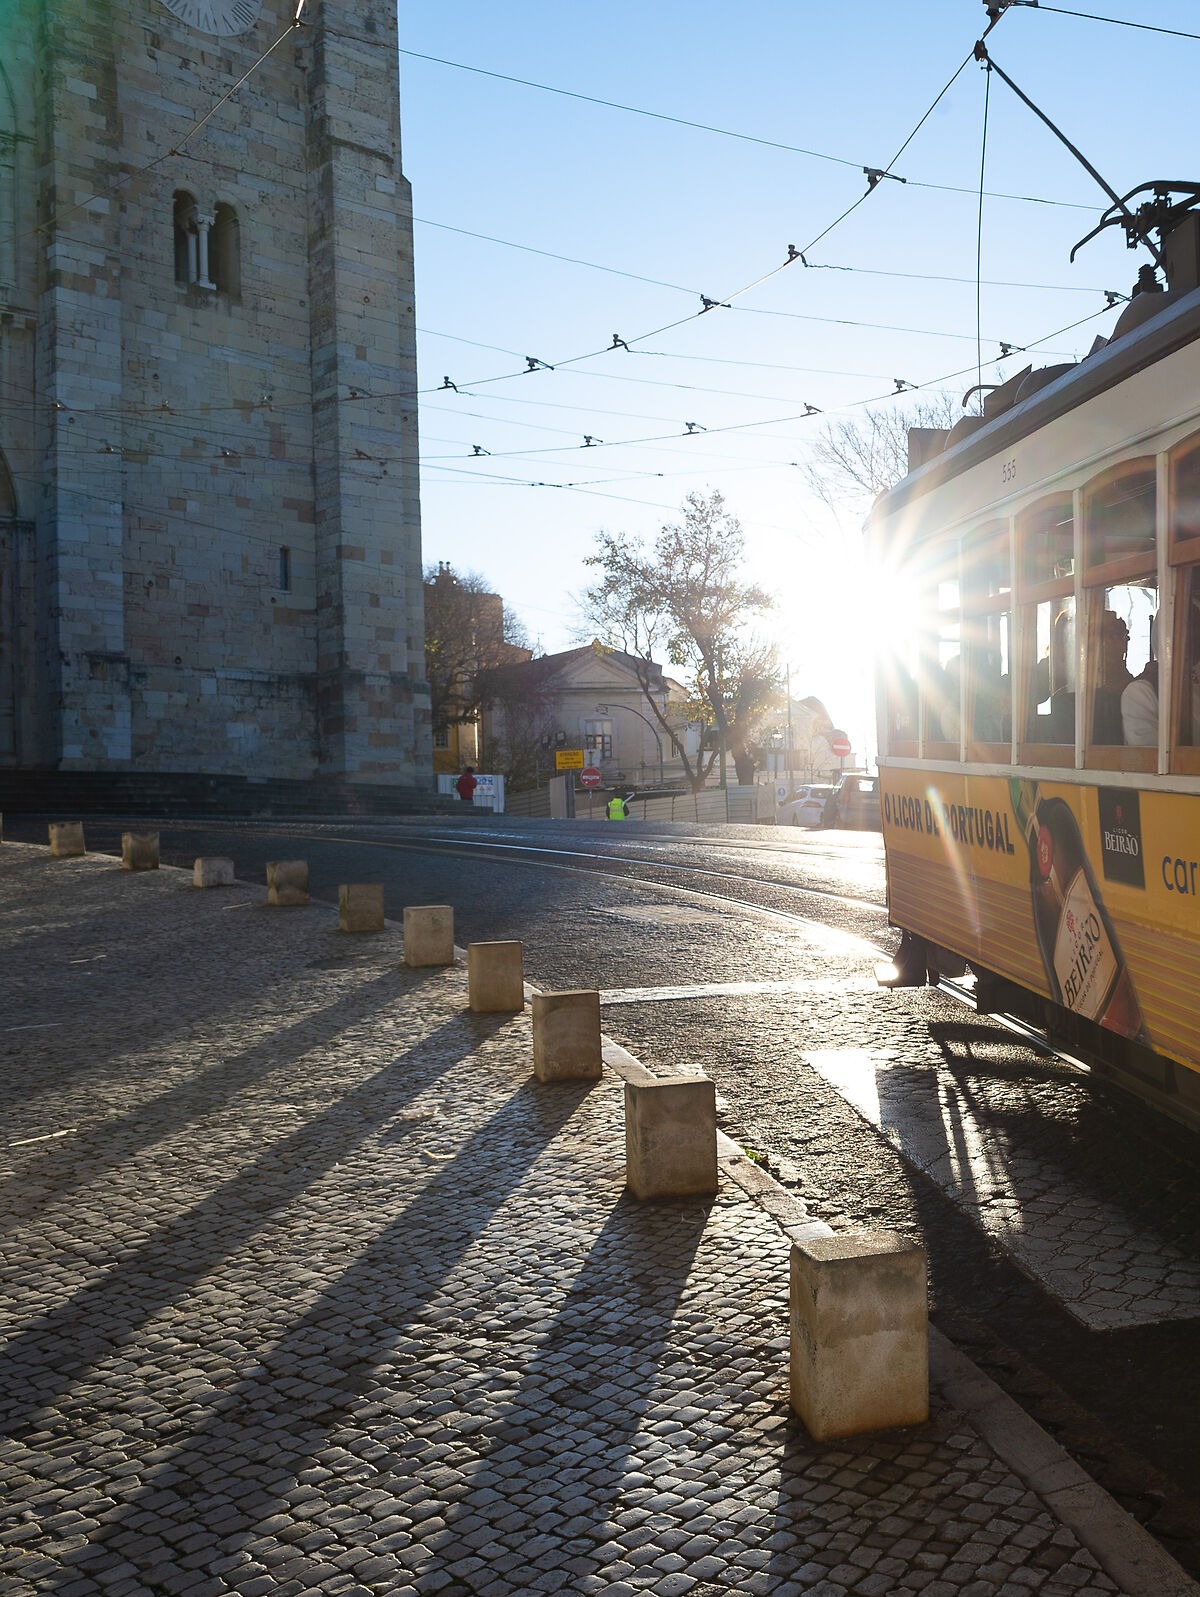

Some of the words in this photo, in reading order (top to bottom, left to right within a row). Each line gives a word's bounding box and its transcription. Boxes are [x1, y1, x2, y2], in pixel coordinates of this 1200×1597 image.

[1002, 458, 1017, 483] 555
[884, 792, 891, 823] O
[891, 793, 923, 834] LICOR
[1104, 831, 1139, 856] BEIRÃO
